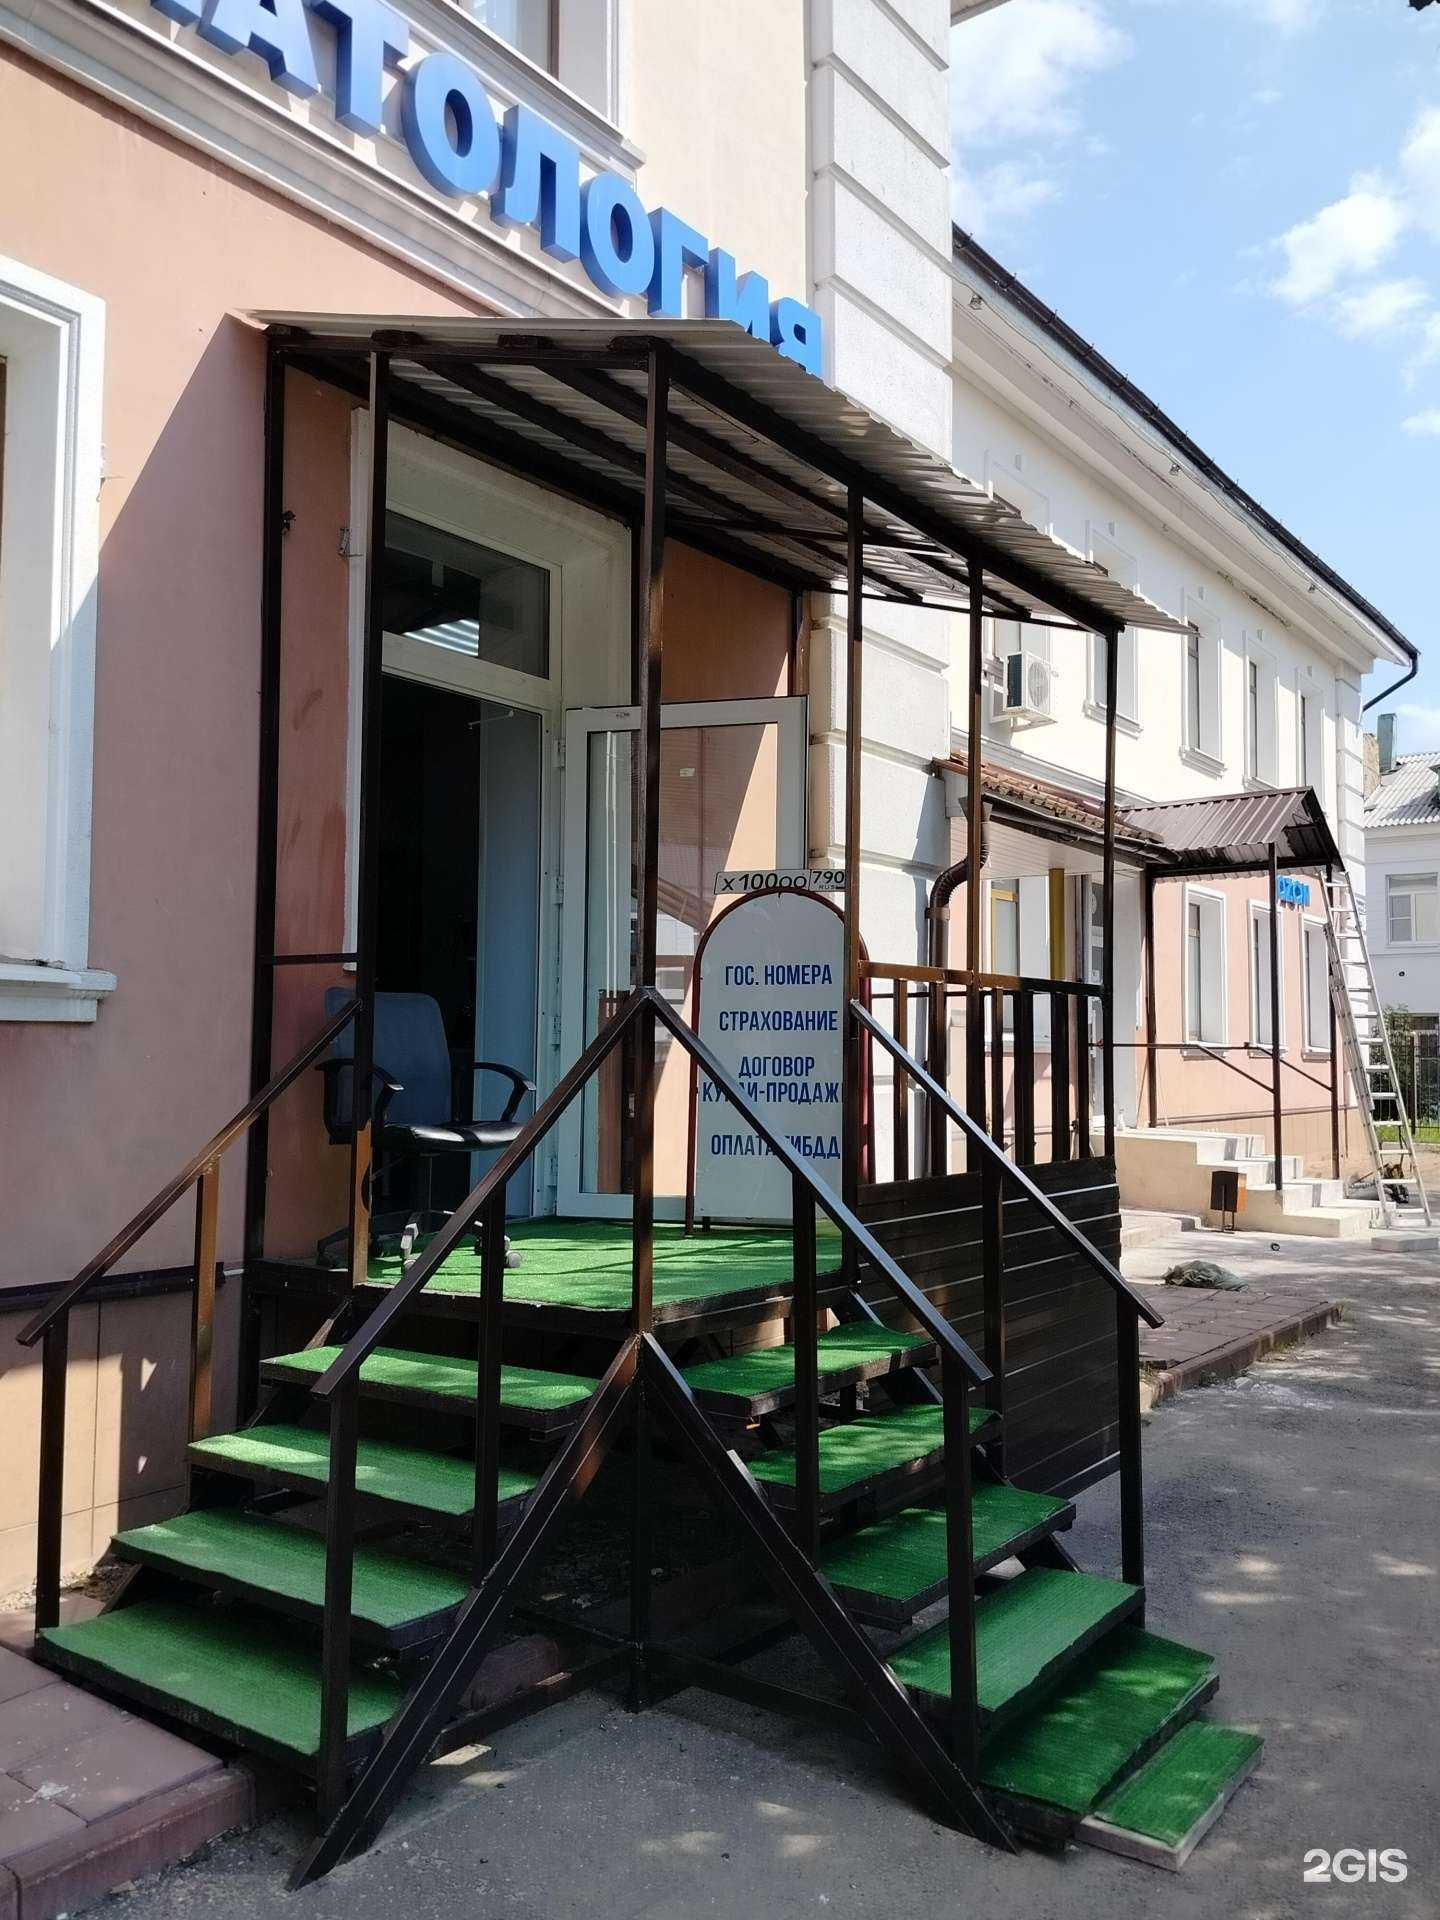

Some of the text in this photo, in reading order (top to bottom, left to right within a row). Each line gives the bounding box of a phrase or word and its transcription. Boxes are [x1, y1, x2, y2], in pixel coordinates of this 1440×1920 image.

[812, 870, 845, 884] 790
[725, 964, 833, 986] ГОС. НОМЕРА
[719, 1010, 838, 1031] СТРАХОВАНИЕ
[738, 1056, 815, 1078] ДОГОВОР
[784, 1135, 841, 1160] ИБДД
